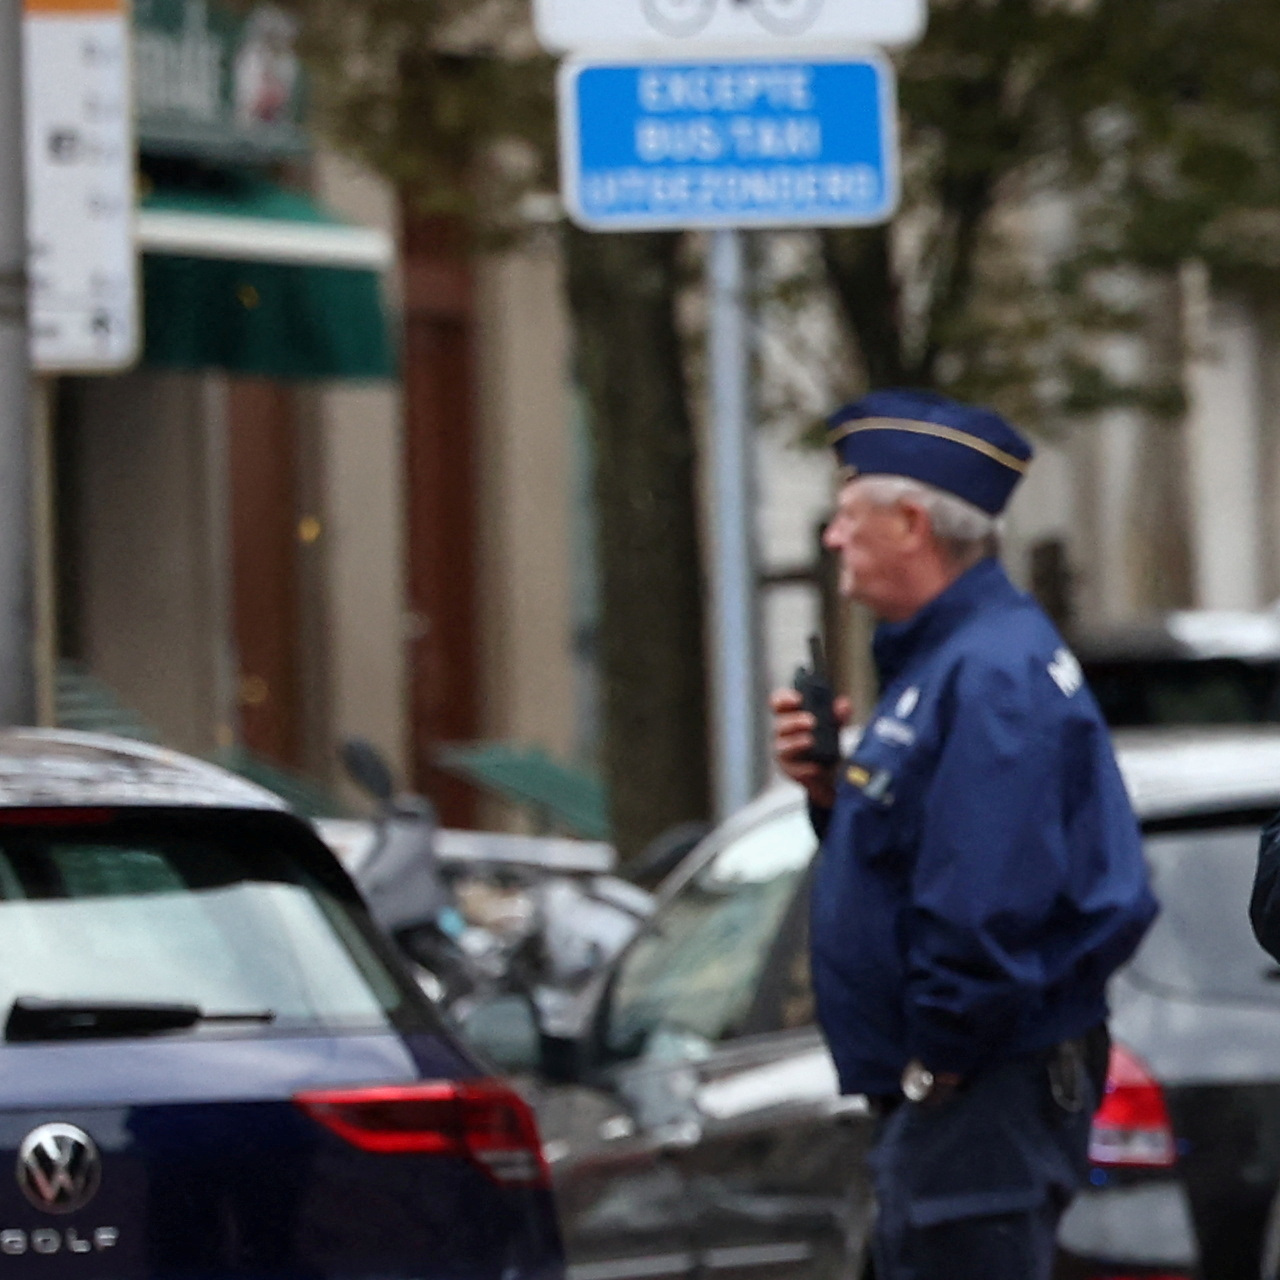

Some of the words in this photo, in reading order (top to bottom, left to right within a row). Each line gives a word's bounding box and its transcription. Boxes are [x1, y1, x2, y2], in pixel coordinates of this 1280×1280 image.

[637, 117, 720, 161] BUS
[731, 116, 822, 159] TAXI
[0, 1225, 119, 1255] GOLF
